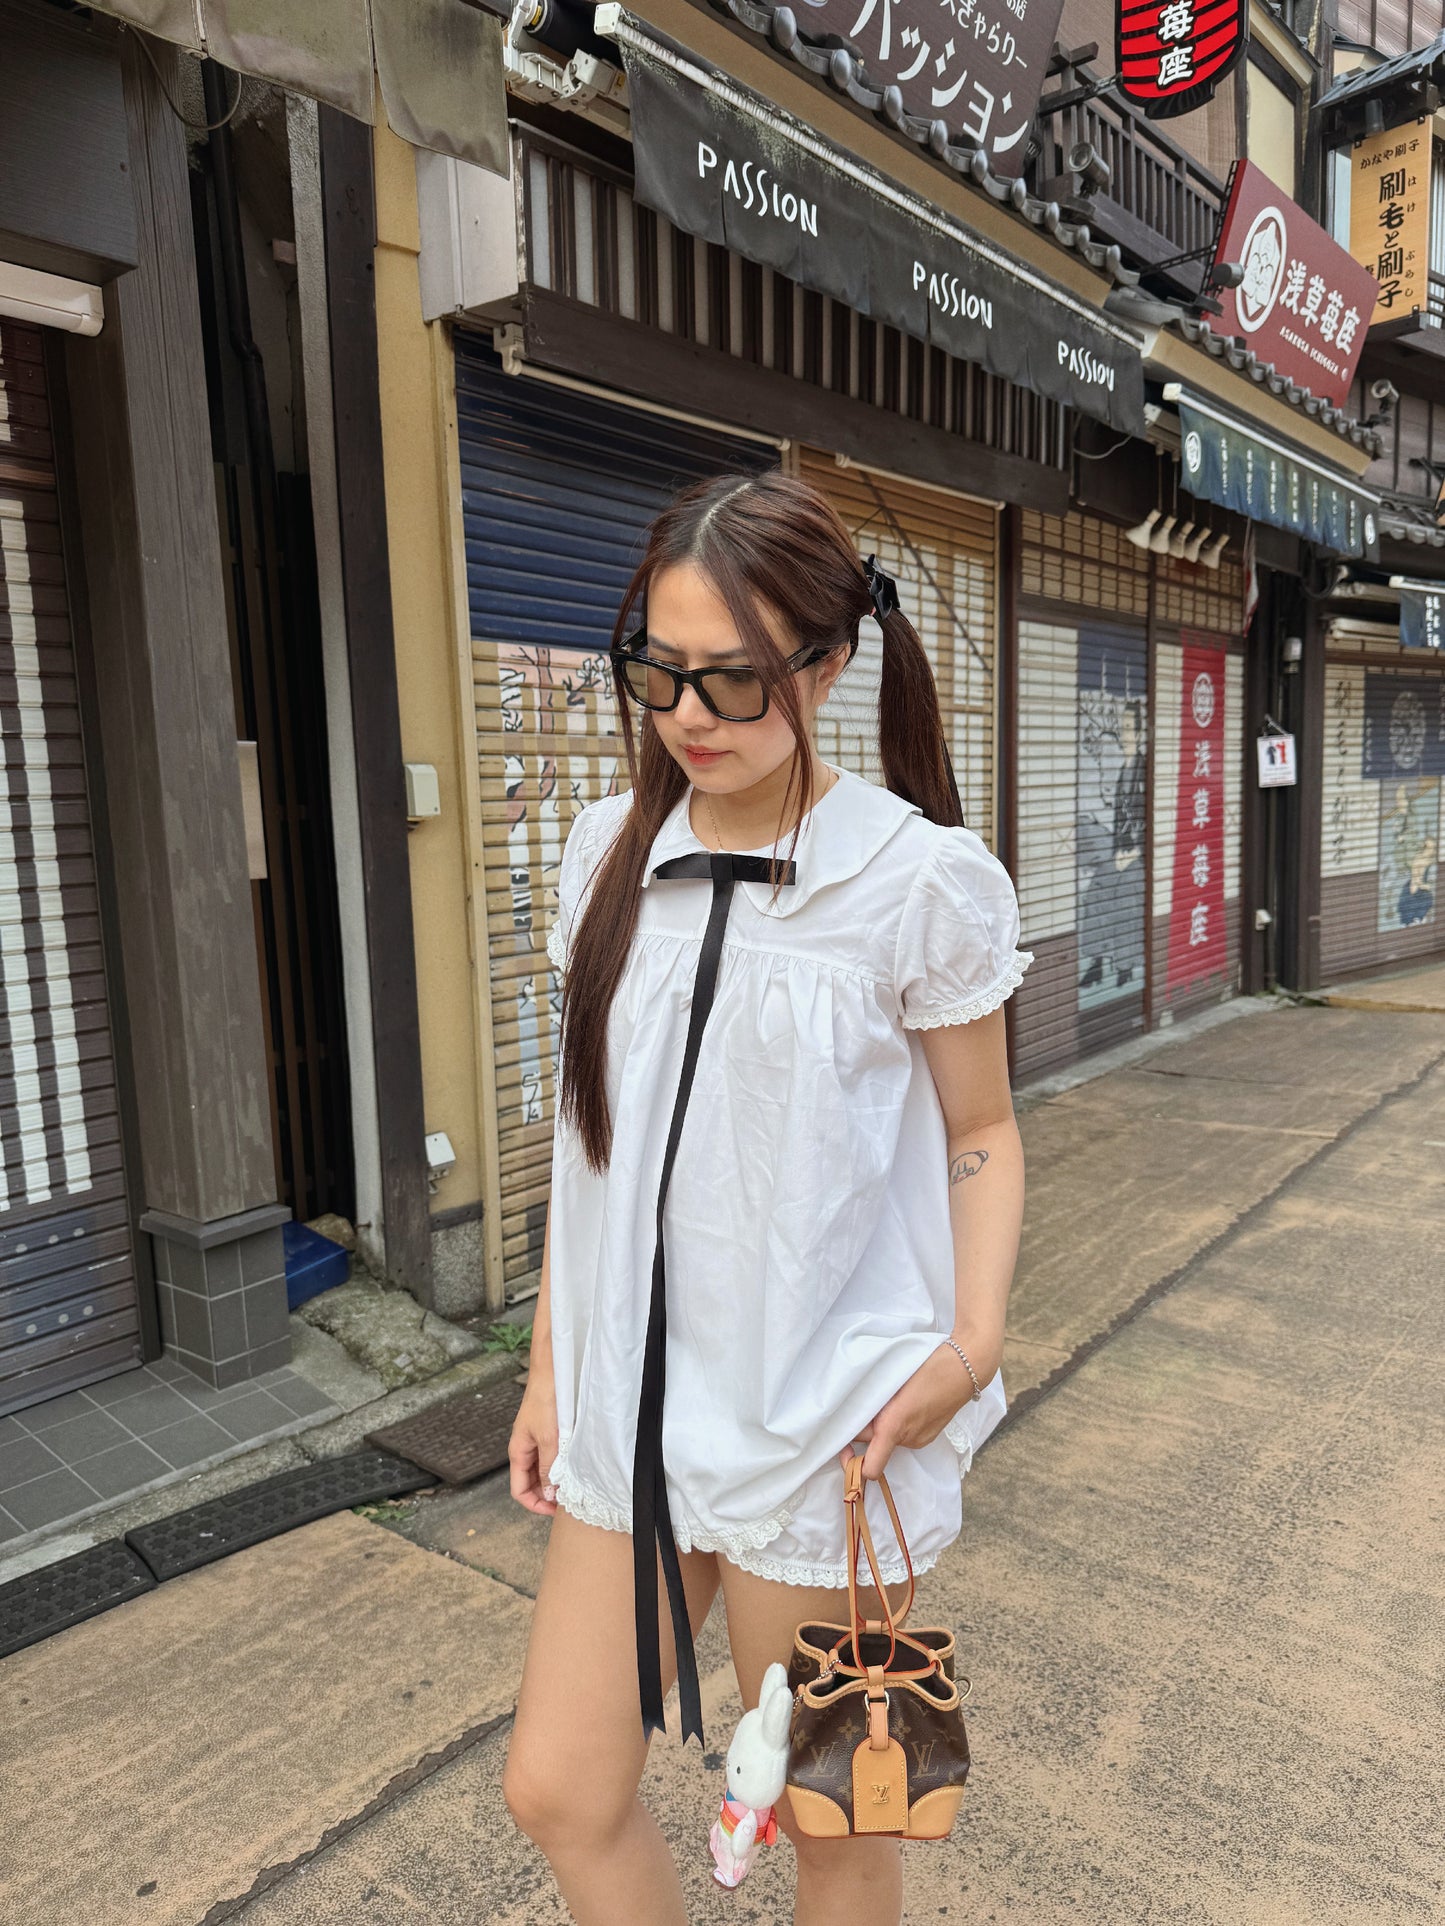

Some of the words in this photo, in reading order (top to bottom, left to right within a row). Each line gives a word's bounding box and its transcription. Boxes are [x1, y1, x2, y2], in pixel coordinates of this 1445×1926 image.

[1158, 0, 1194, 86] 苺座
[698, 141, 818, 238] PASSION
[1360, 138, 1420, 170] かなや刷子
[1377, 168, 1406, 308] 刷毛と刷子
[912, 260, 993, 329] PASSION
[1279, 258, 1361, 356] 浅草苺座
[1057, 340, 1115, 392] PASSION
